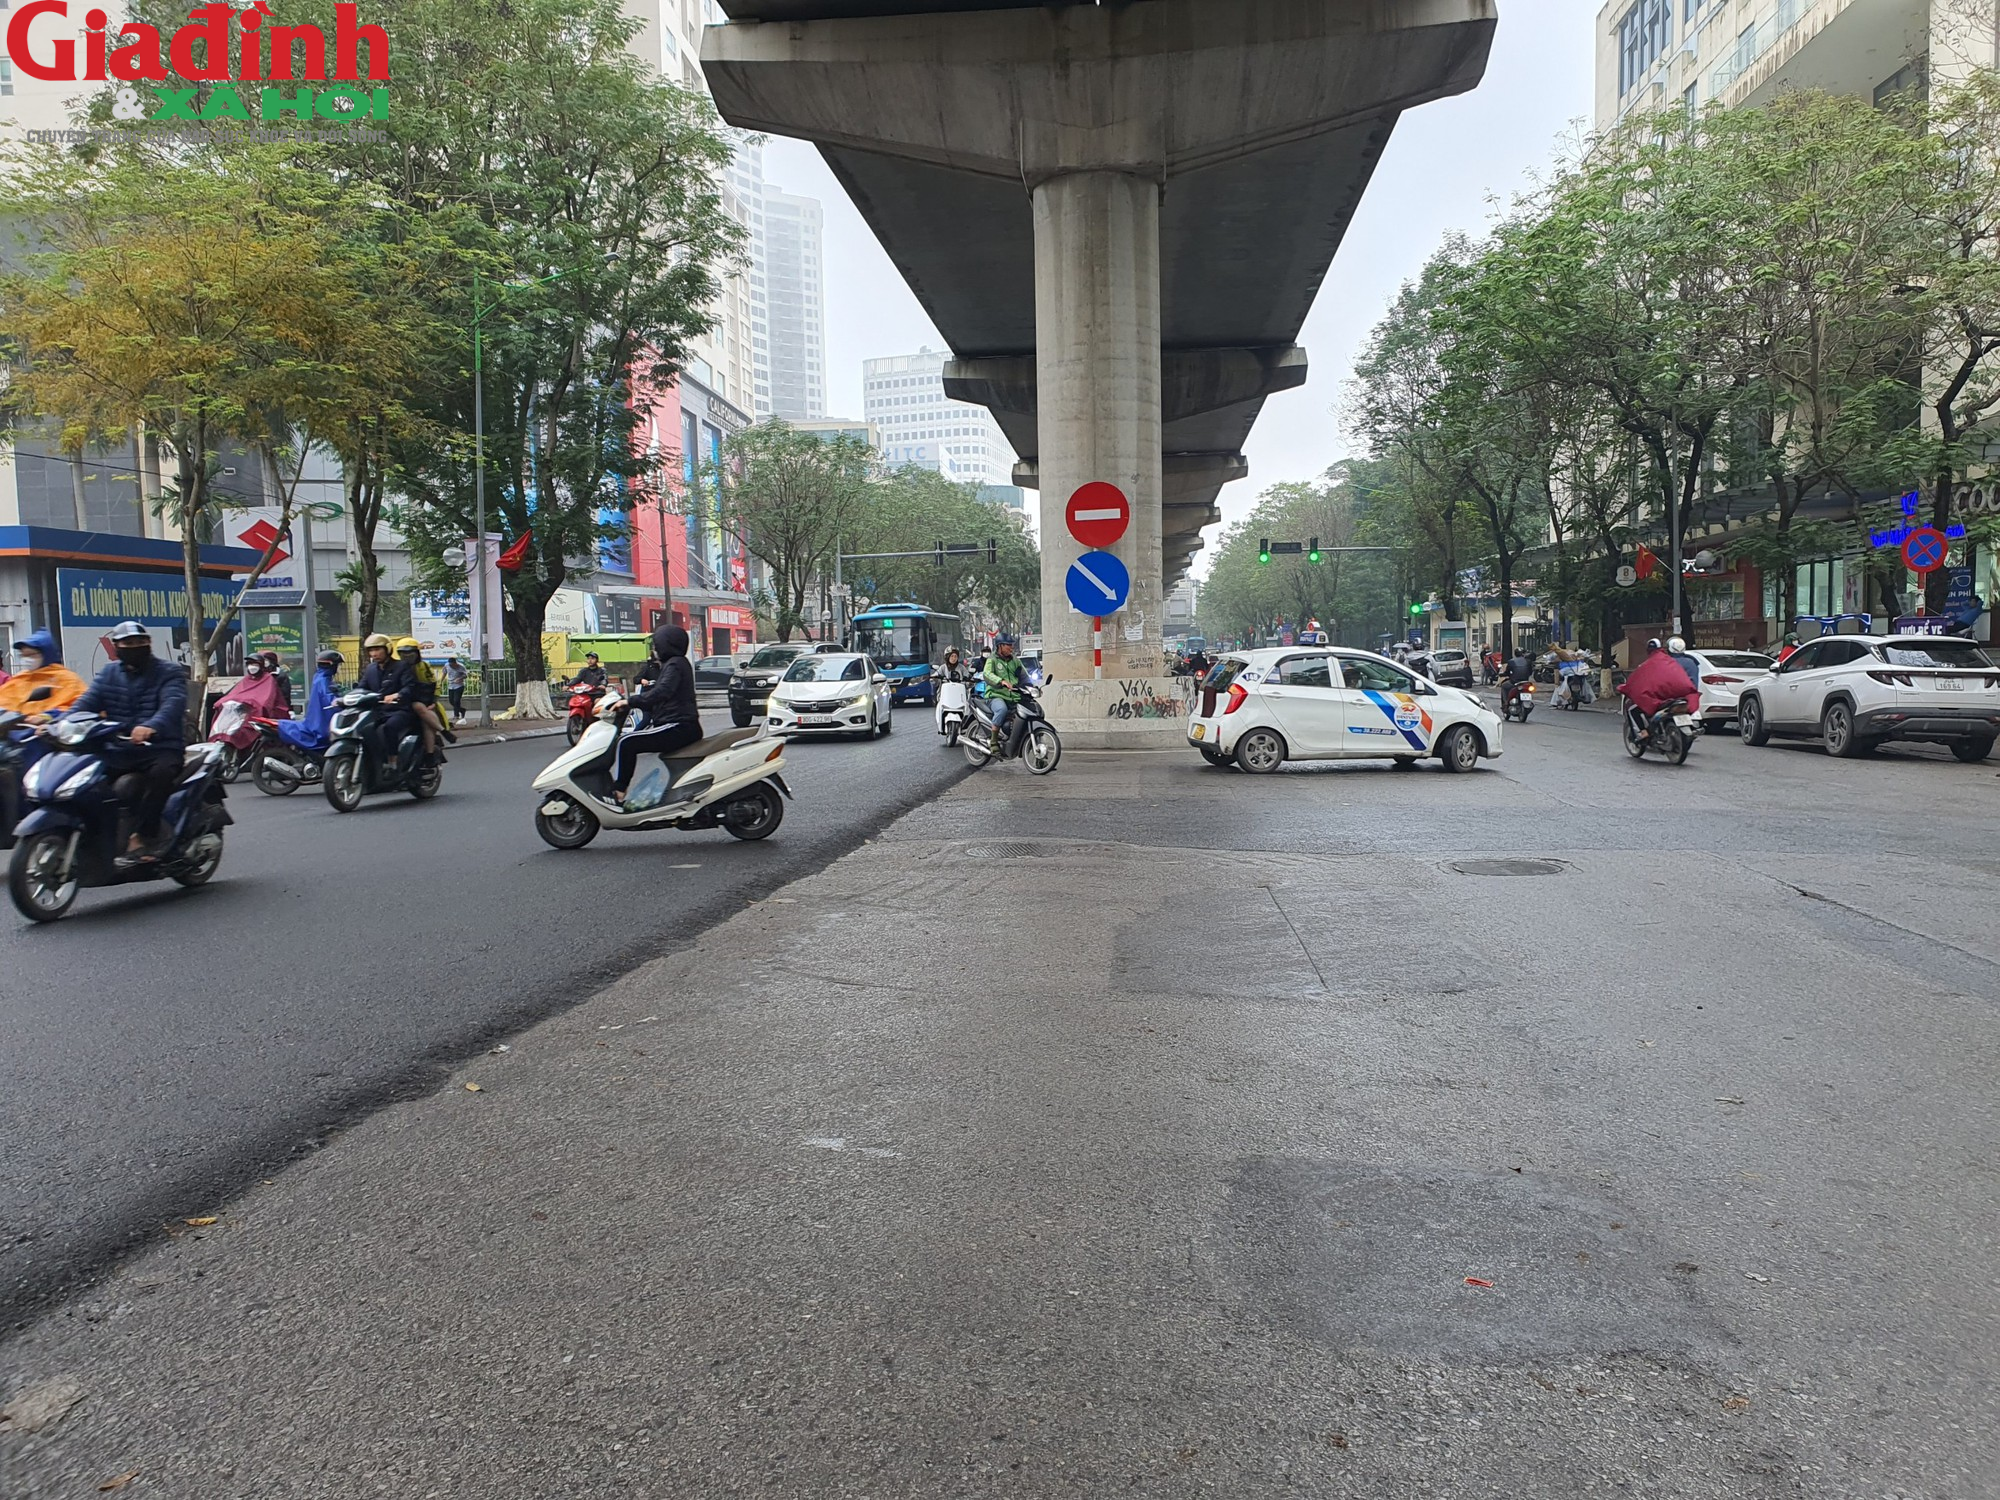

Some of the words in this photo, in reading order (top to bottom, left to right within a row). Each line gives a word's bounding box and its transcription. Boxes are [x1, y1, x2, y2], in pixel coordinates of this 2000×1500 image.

[71, 582, 88, 617] ĐÃ
[89, 578, 120, 617] UỐNG
[121, 587, 149, 624] RƯỢU
[150, 590, 168, 617] BIA
